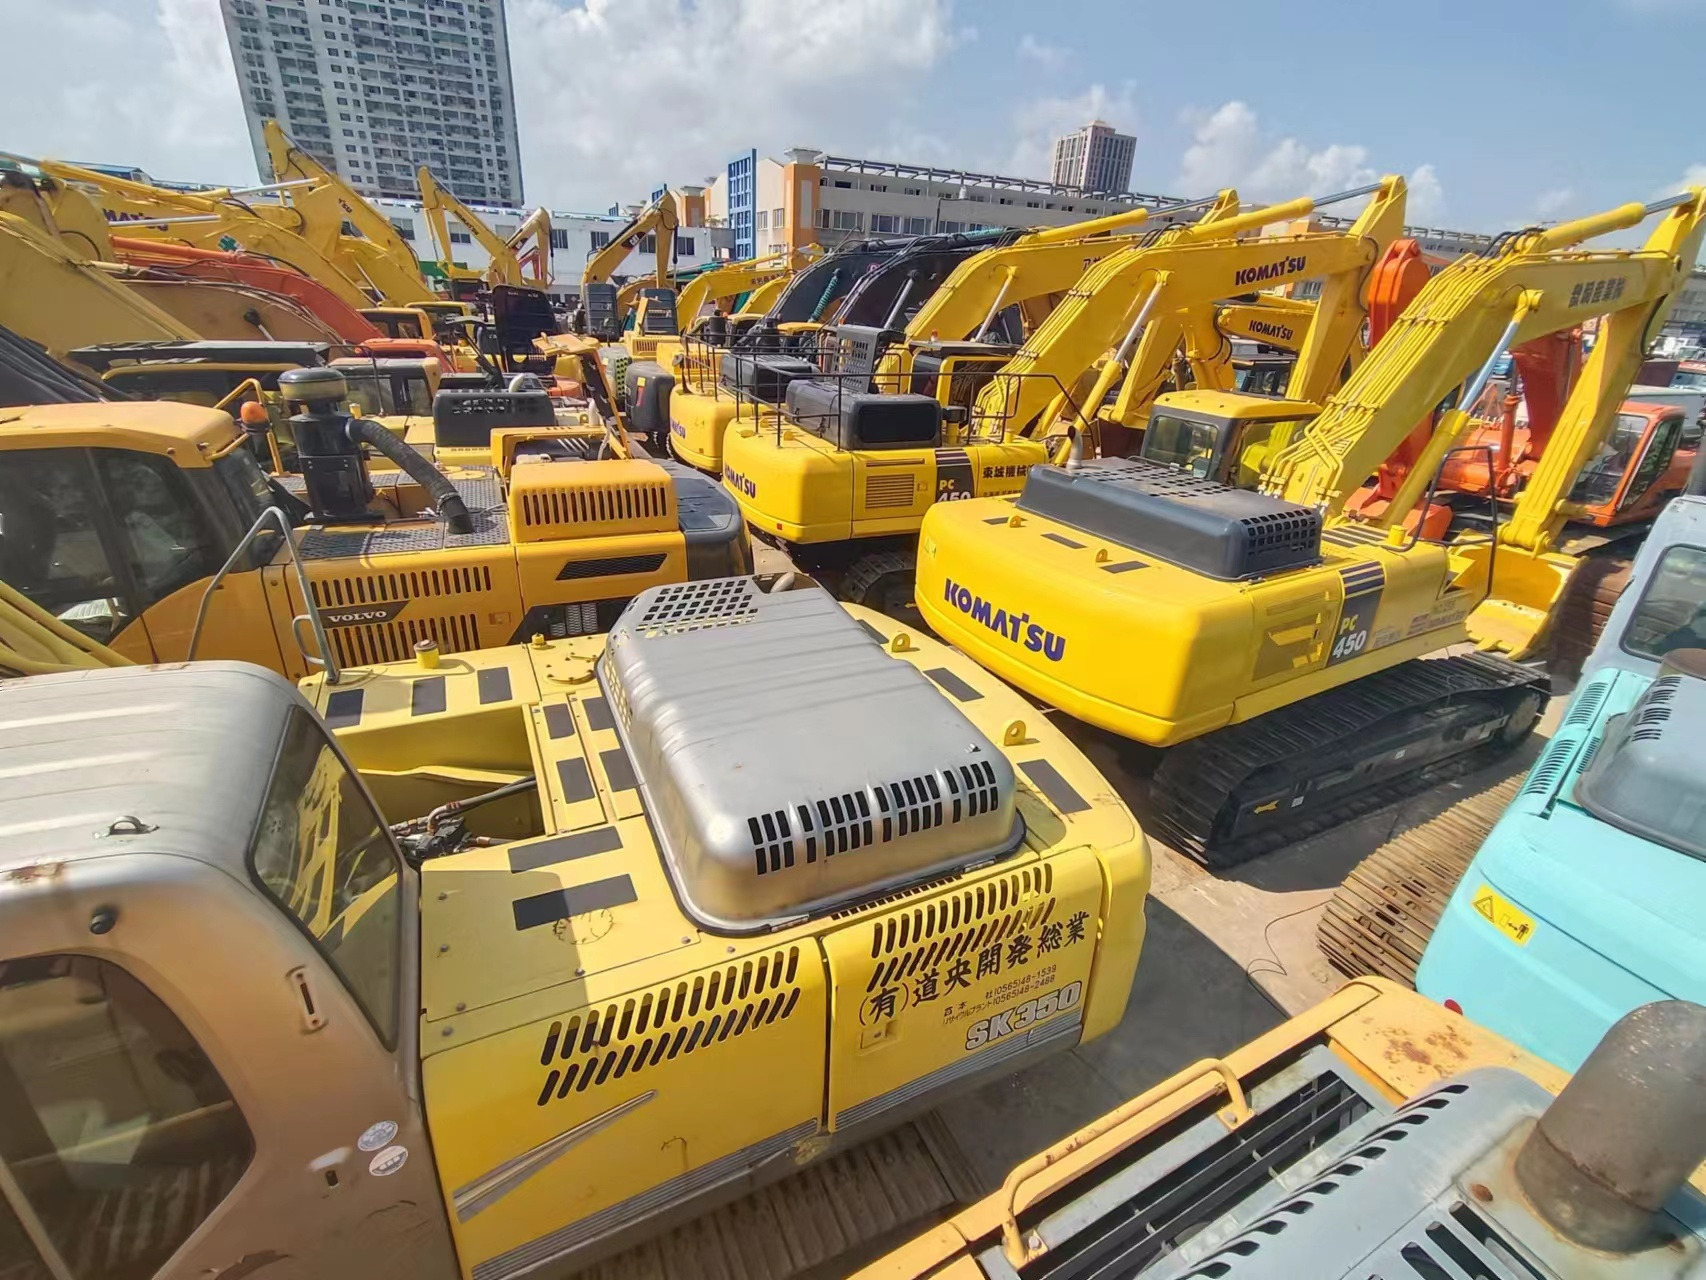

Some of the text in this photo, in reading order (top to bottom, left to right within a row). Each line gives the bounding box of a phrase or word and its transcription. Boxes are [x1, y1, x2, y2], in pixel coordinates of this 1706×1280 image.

[1235, 256, 1306, 286] KOMATSU
[1249, 320, 1294, 341] KOMATSU
[940, 479, 955, 490] PC
[328, 610, 387, 623] VOLVO
[944, 578, 1066, 662] KOMATSU
[1340, 614, 1359, 634] PC
[1332, 630, 1367, 659] 450
[965, 980, 1083, 1051] SK350
